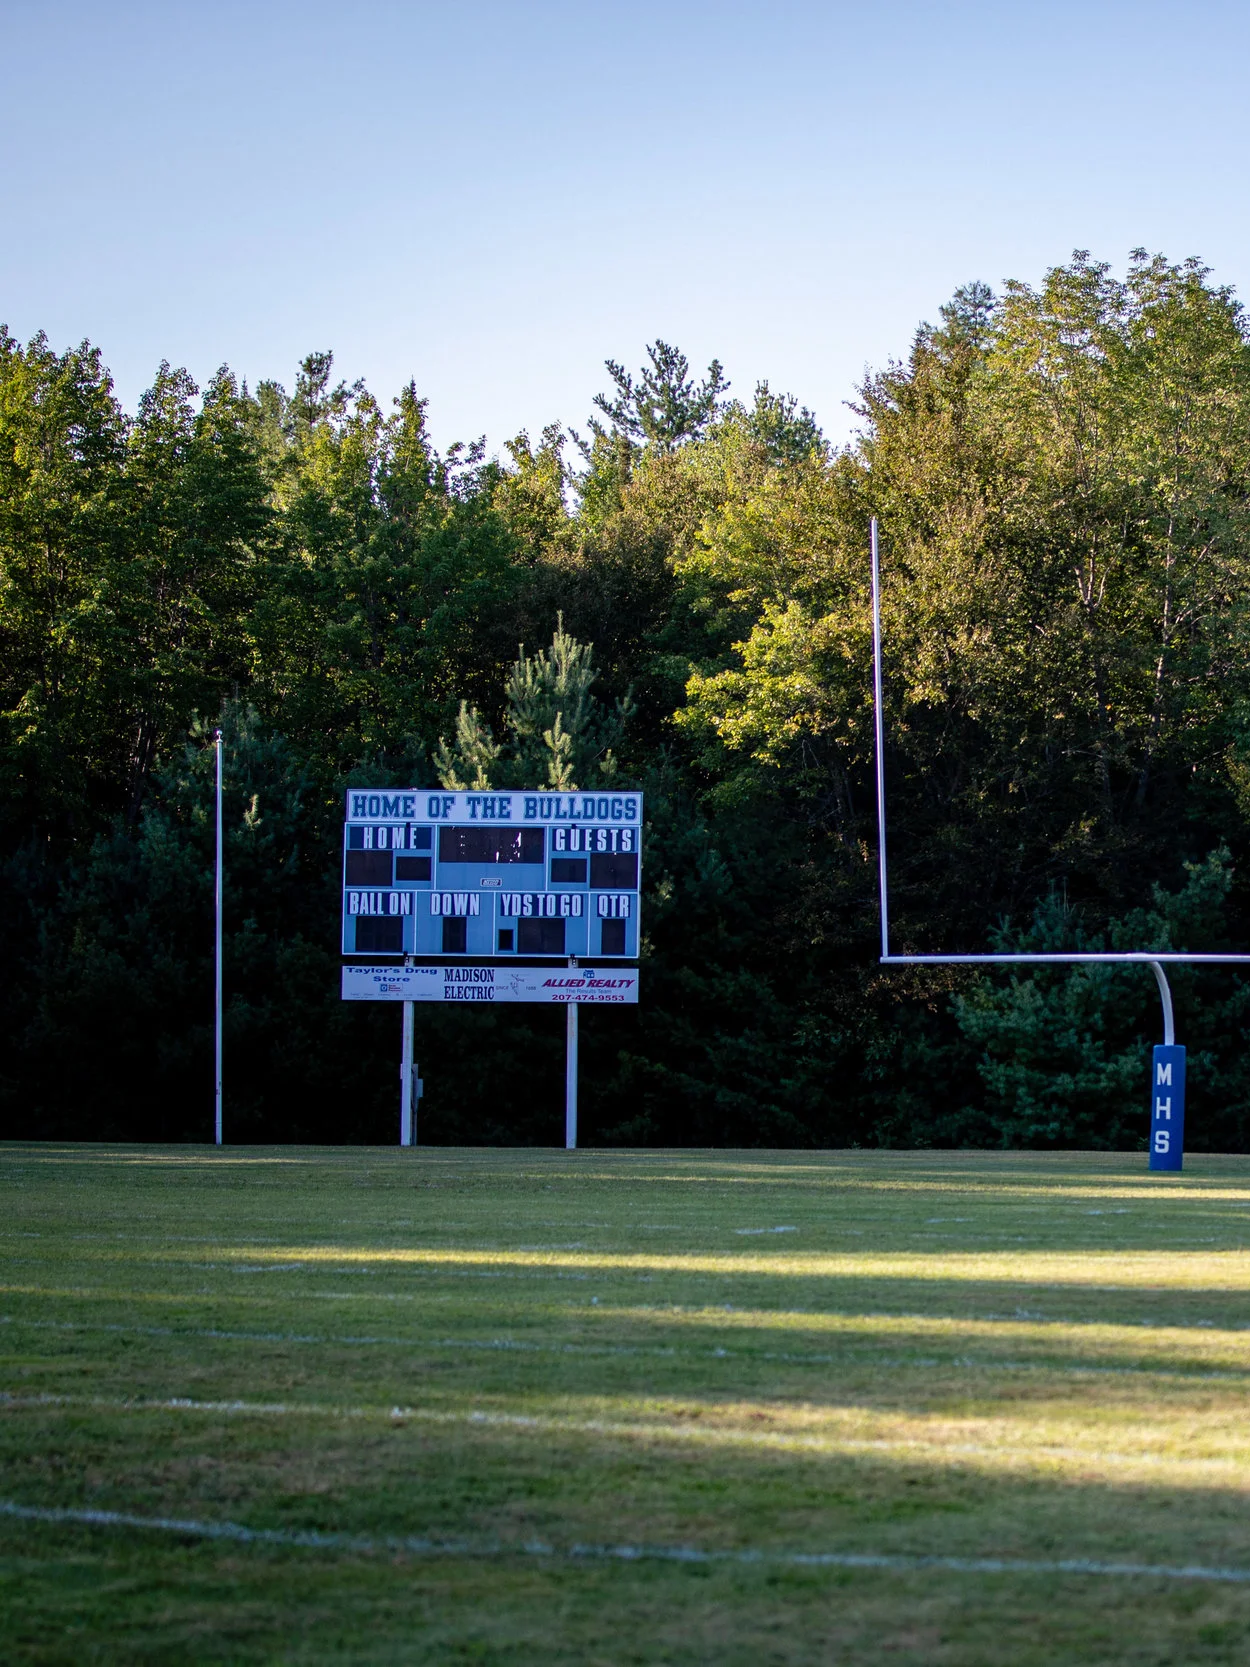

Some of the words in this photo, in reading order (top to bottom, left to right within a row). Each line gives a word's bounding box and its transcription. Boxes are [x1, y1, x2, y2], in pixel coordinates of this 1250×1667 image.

[352, 794, 416, 818] HOME
[426, 795, 456, 819] OF
[465, 796, 512, 819] THE
[523, 796, 638, 820] BULLDOGS
[363, 827, 417, 849] HOME
[555, 828, 632, 851] GUESTS
[349, 892, 384, 915] BALL
[389, 892, 410, 915] ON
[430, 893, 480, 916] DOWN
[501, 894, 533, 916] YDS
[537, 894, 556, 916] TO
[560, 894, 581, 917] GO
[598, 895, 629, 917] QTR
[405, 967, 437, 975] Drug
[444, 969, 494, 982] MADISON
[444, 986, 494, 1000] ELECTRIC
[542, 979, 586, 987] ALLIED
[586, 979, 635, 988] REALTY
[1154, 1063, 1172, 1153] MHS
